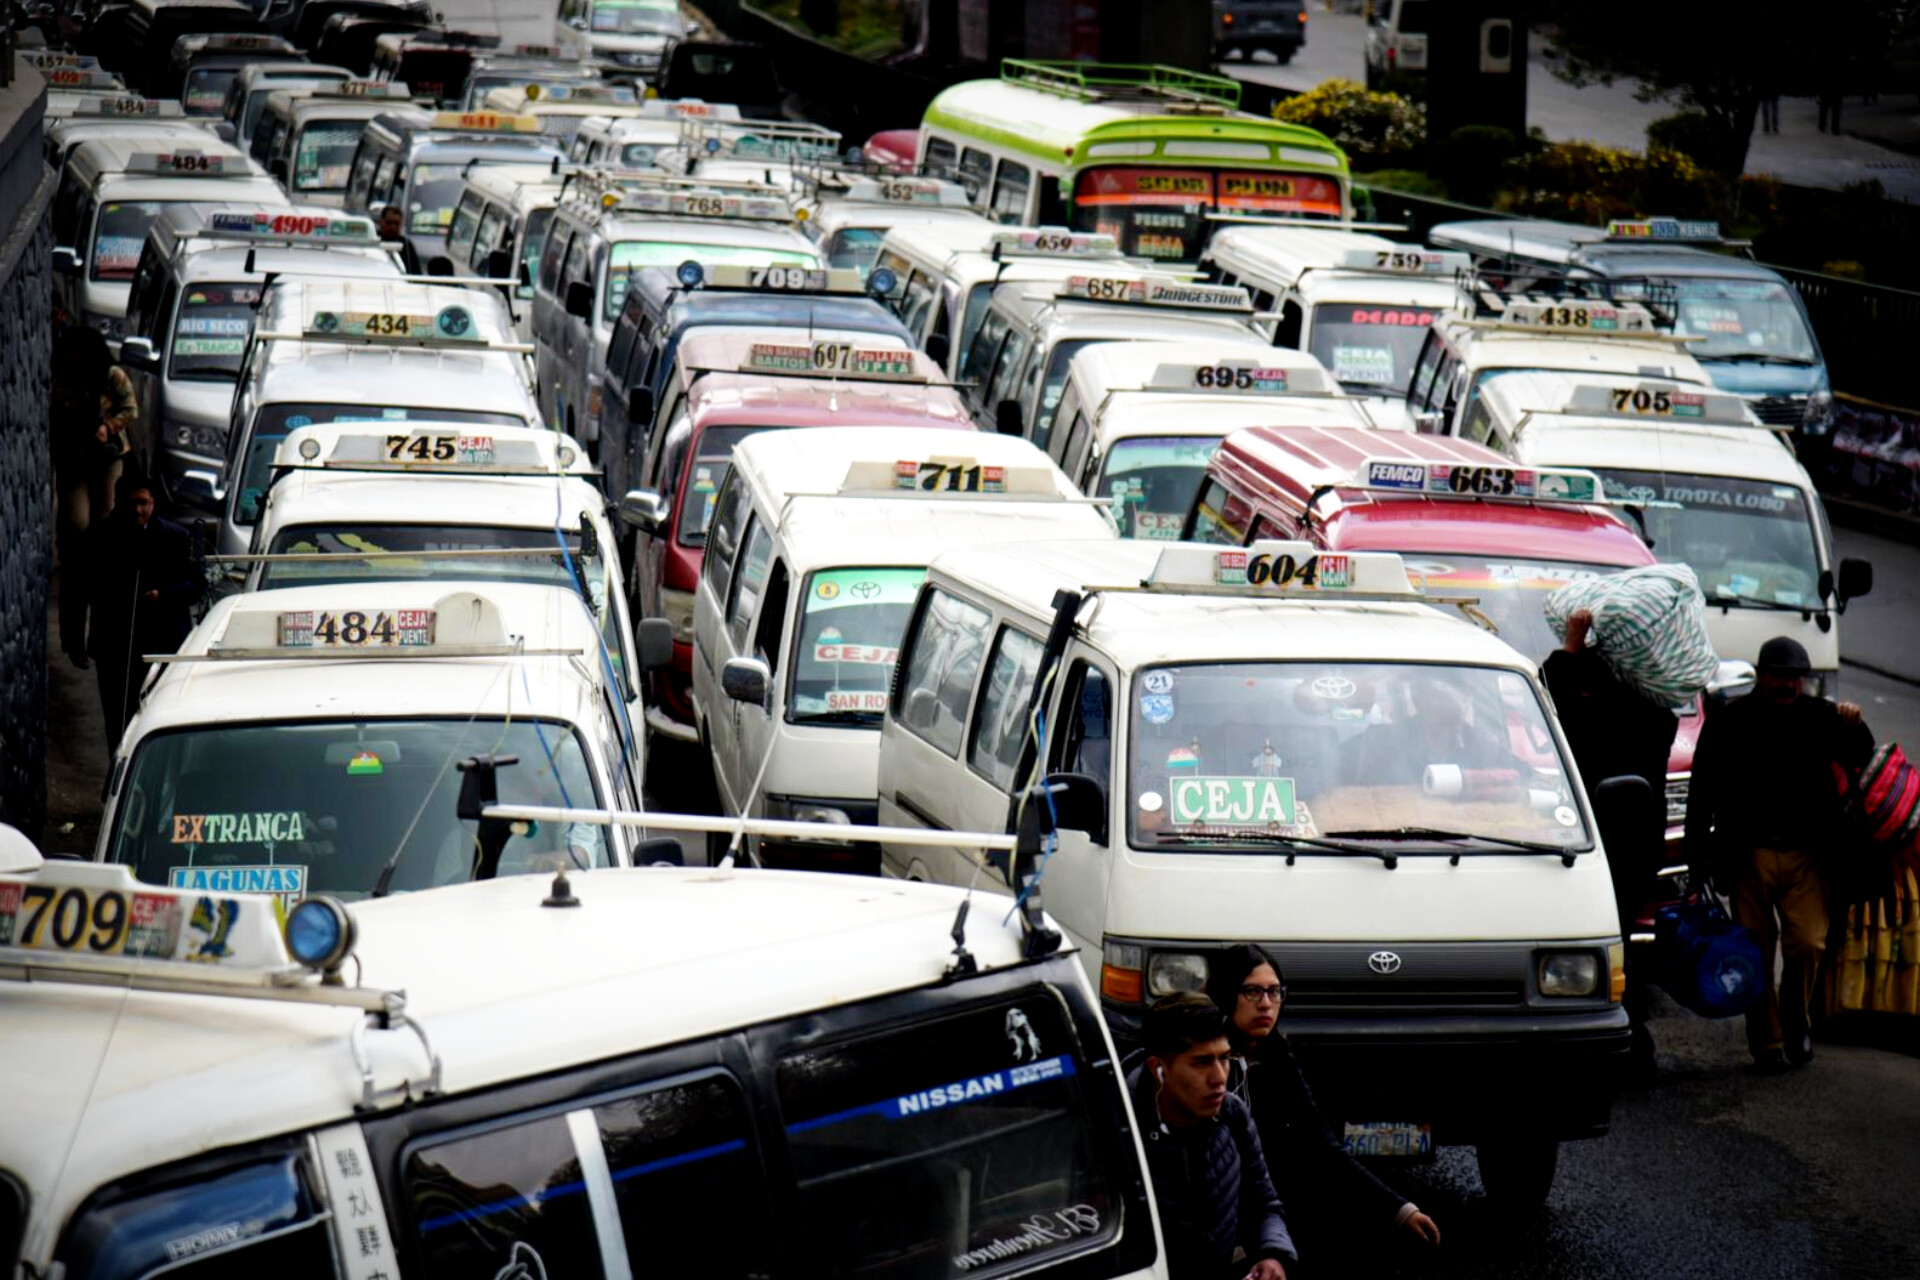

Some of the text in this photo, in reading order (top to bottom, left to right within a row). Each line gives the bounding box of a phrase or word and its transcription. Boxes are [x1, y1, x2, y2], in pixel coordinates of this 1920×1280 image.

[115, 99, 145, 113] 484
[172, 155, 209, 171] 484
[687, 197, 724, 214] 768
[270, 214, 314, 236] 490
[1035, 236, 1073, 251] 659
[1375, 252, 1422, 271] 759
[751, 267, 805, 290] 709
[1087, 278, 1247, 306] 687 BRIDGESTONE
[181, 319, 244, 334] RIO SECO
[365, 313, 409, 335] 434
[1540, 307, 1588, 328] 438
[813, 344, 850, 370] 697
[1196, 366, 1253, 389] 695
[1612, 388, 1671, 413] 705
[386, 434, 456, 460] 745
[459, 436, 494, 450] CEJA
[918, 462, 982, 492] 711
[1370, 465, 1424, 483] FEMCO
[1450, 466, 1515, 496] 663
[1664, 486, 1786, 512] TOYOTA LOBO
[1247, 554, 1320, 586] 604
[313, 611, 396, 644] 484
[398, 612, 427, 626] CEJA
[398, 629, 428, 645] PUENTE
[1149, 675, 1168, 690] 21
[828, 694, 889, 710] SAN RO
[1176, 779, 1287, 822] CEJA
[171, 811, 305, 844] EXTRANCA
[175, 868, 301, 893] LAGUNAS
[20, 885, 127, 952] 709
[899, 1073, 1004, 1116] NISSAN
